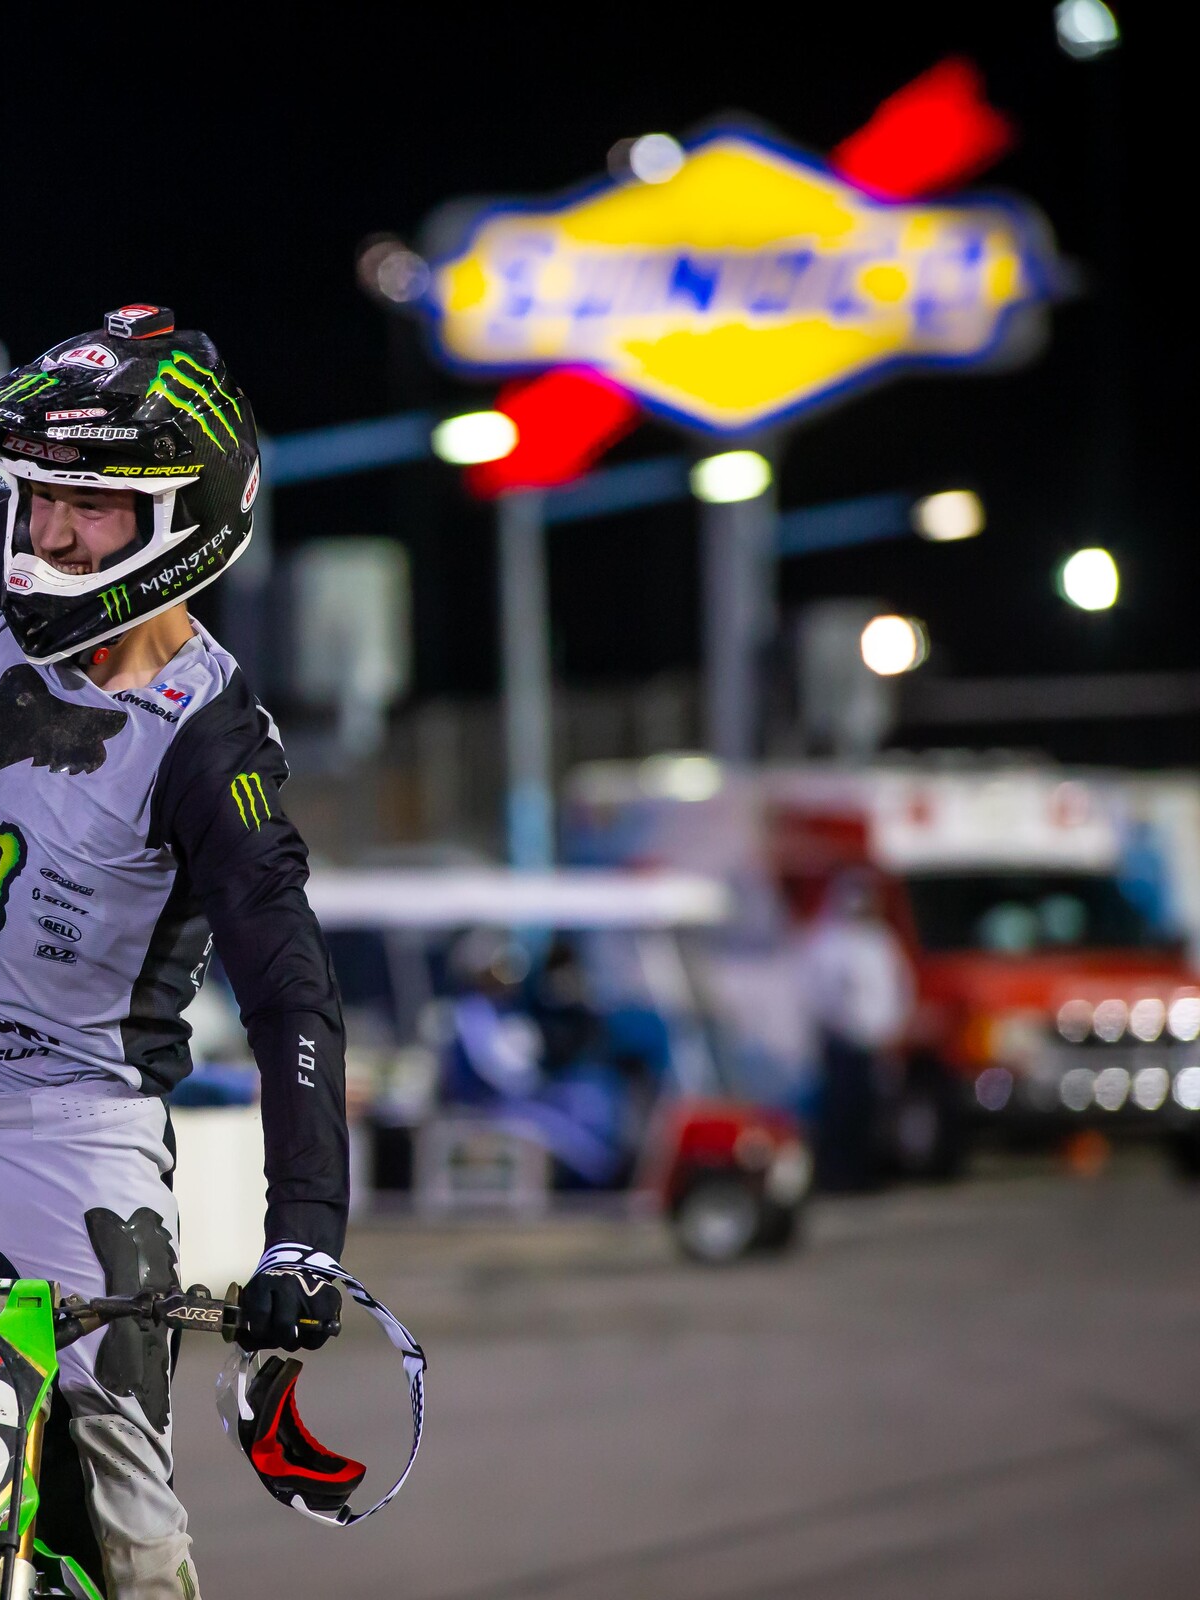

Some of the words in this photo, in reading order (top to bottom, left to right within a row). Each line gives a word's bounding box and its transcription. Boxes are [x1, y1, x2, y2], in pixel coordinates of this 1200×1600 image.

[103, 465, 141, 476] PRO
[144, 464, 205, 476] CIRCUIT
[140, 524, 233, 595] MONSTER
[9, 576, 29, 589] BELL
[161, 548, 224, 597] ENERGY
[43, 918, 78, 941] BELL
[298, 1034, 315, 1088] FOX
[166, 1306, 222, 1321] ARC
